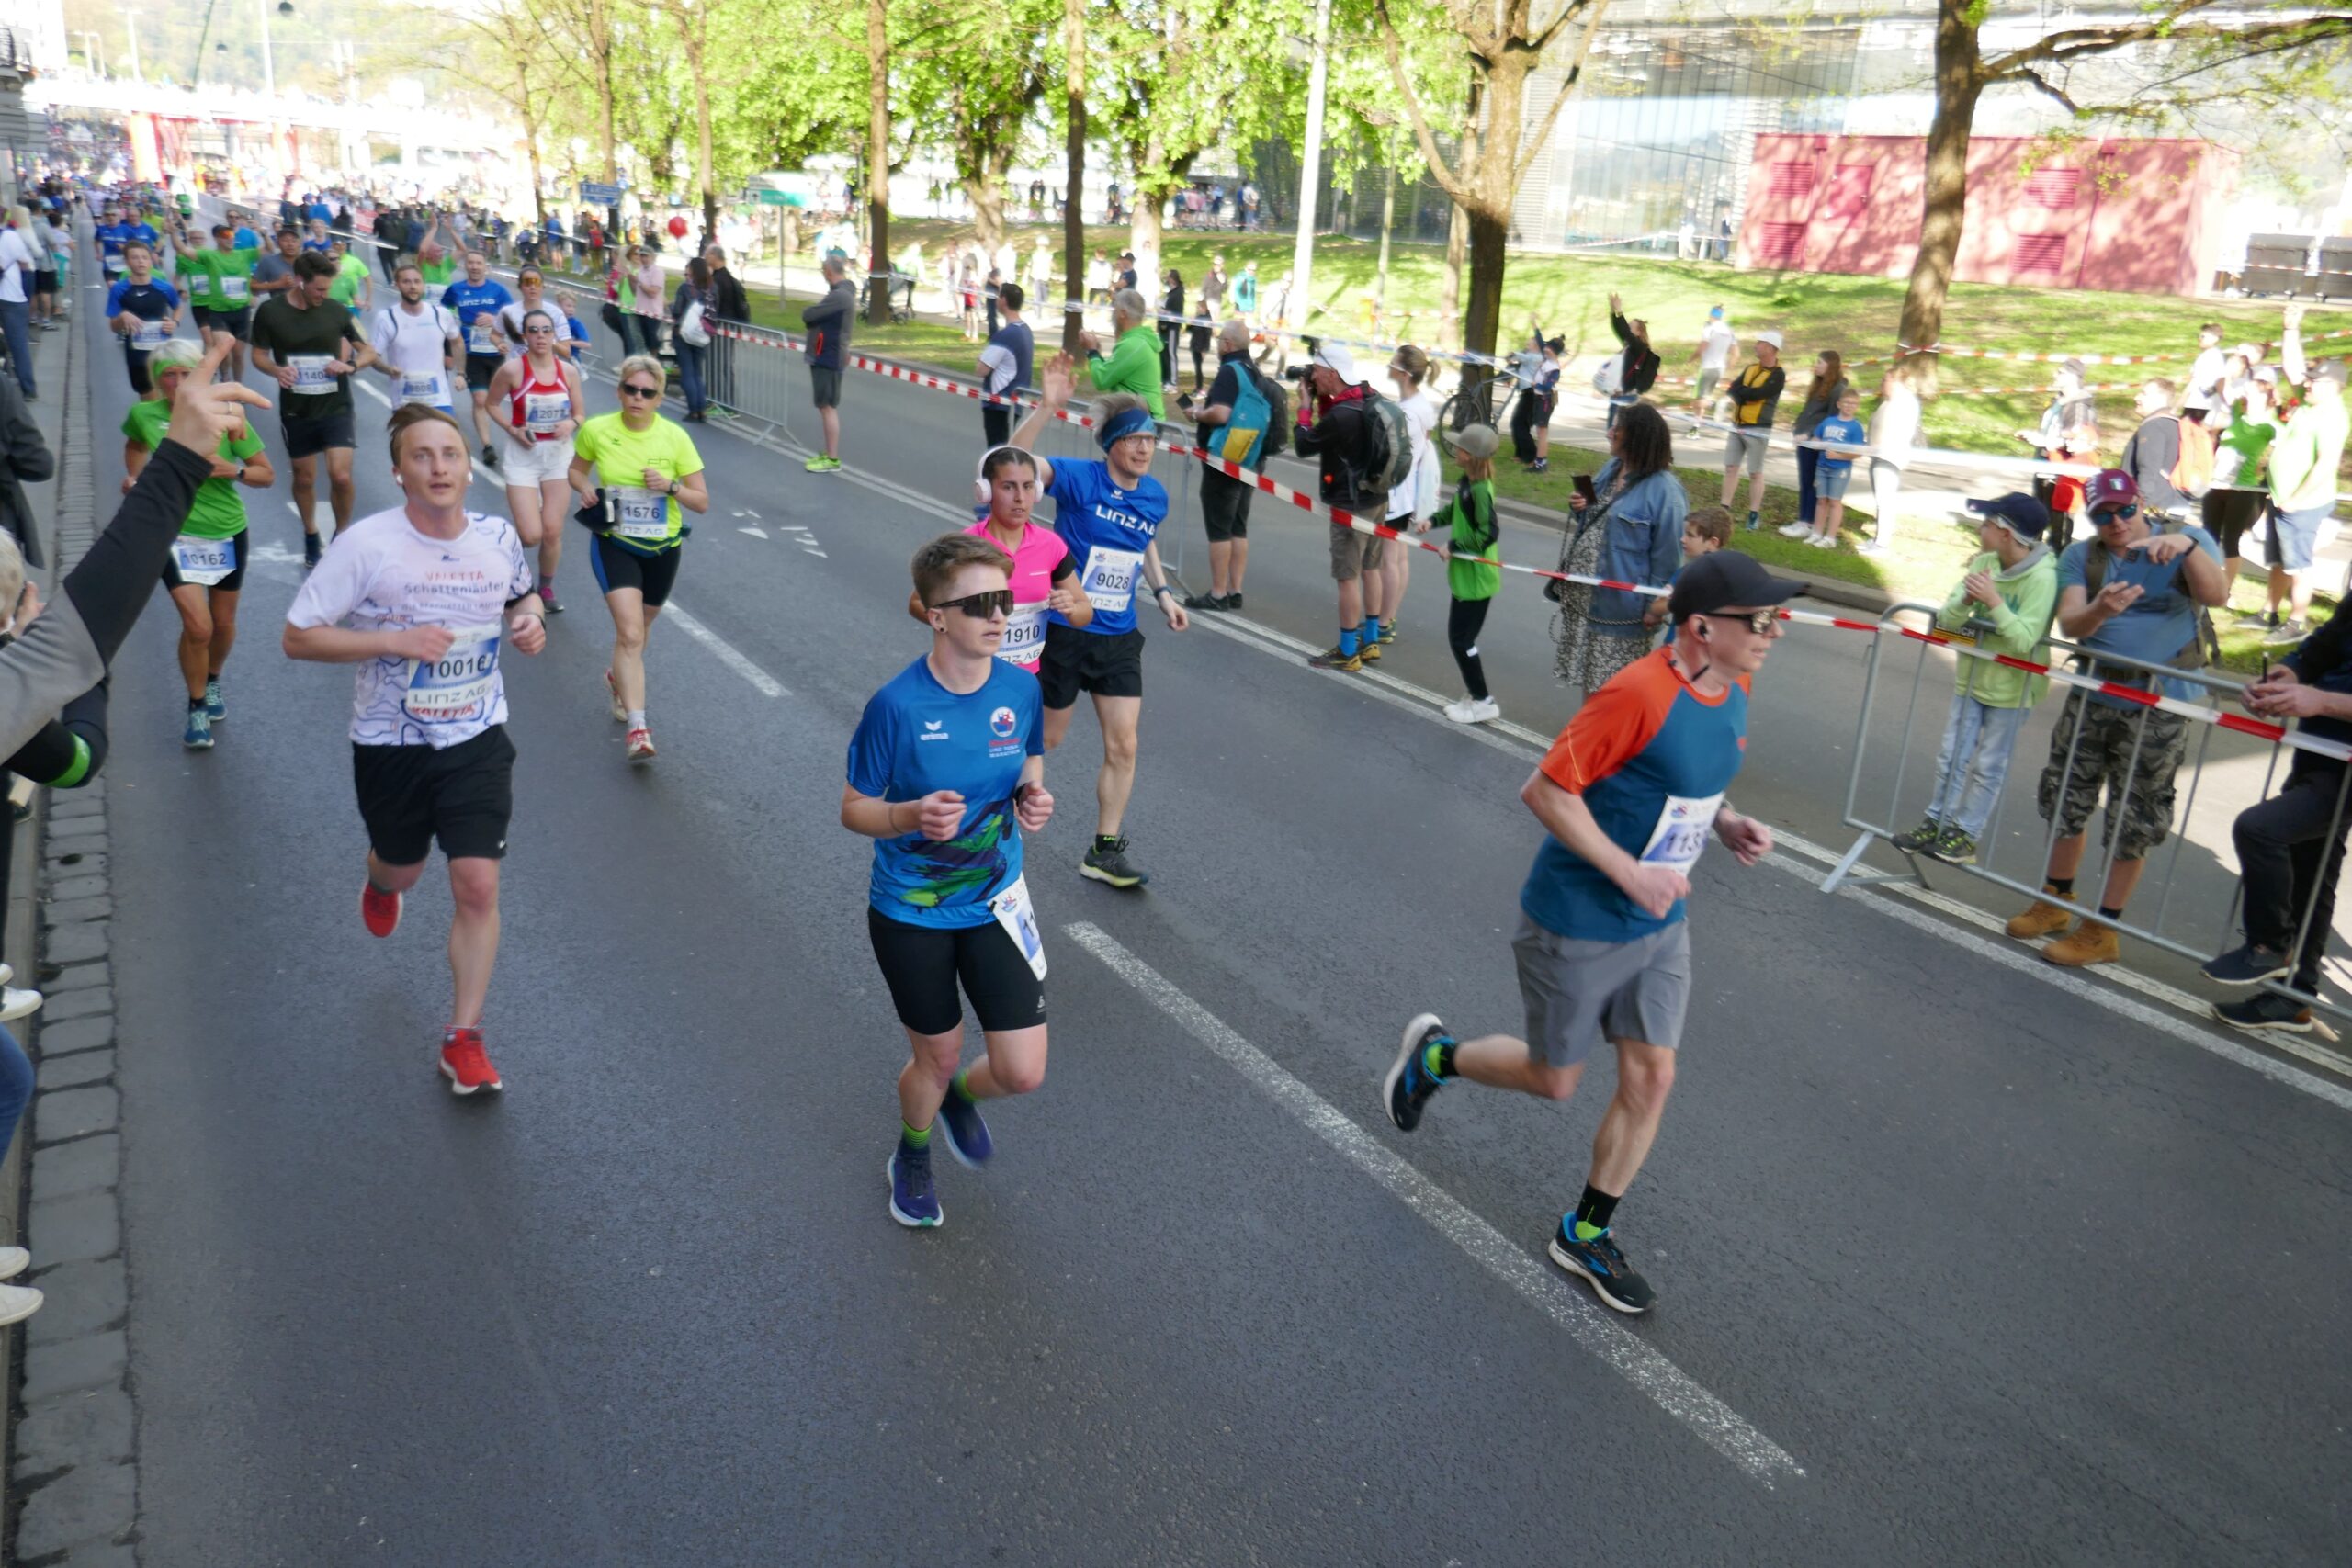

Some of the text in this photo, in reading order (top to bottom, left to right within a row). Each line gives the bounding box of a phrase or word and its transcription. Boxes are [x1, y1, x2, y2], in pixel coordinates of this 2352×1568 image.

[625, 506, 661, 519] 1576
[1095, 504, 1136, 529] LINZ
[183, 552, 229, 566] 10162
[1096, 572, 1130, 590] 9028
[1004, 625, 1040, 643] 1910
[424, 654, 487, 679] 10016
[413, 683, 486, 705] LINZ AG
